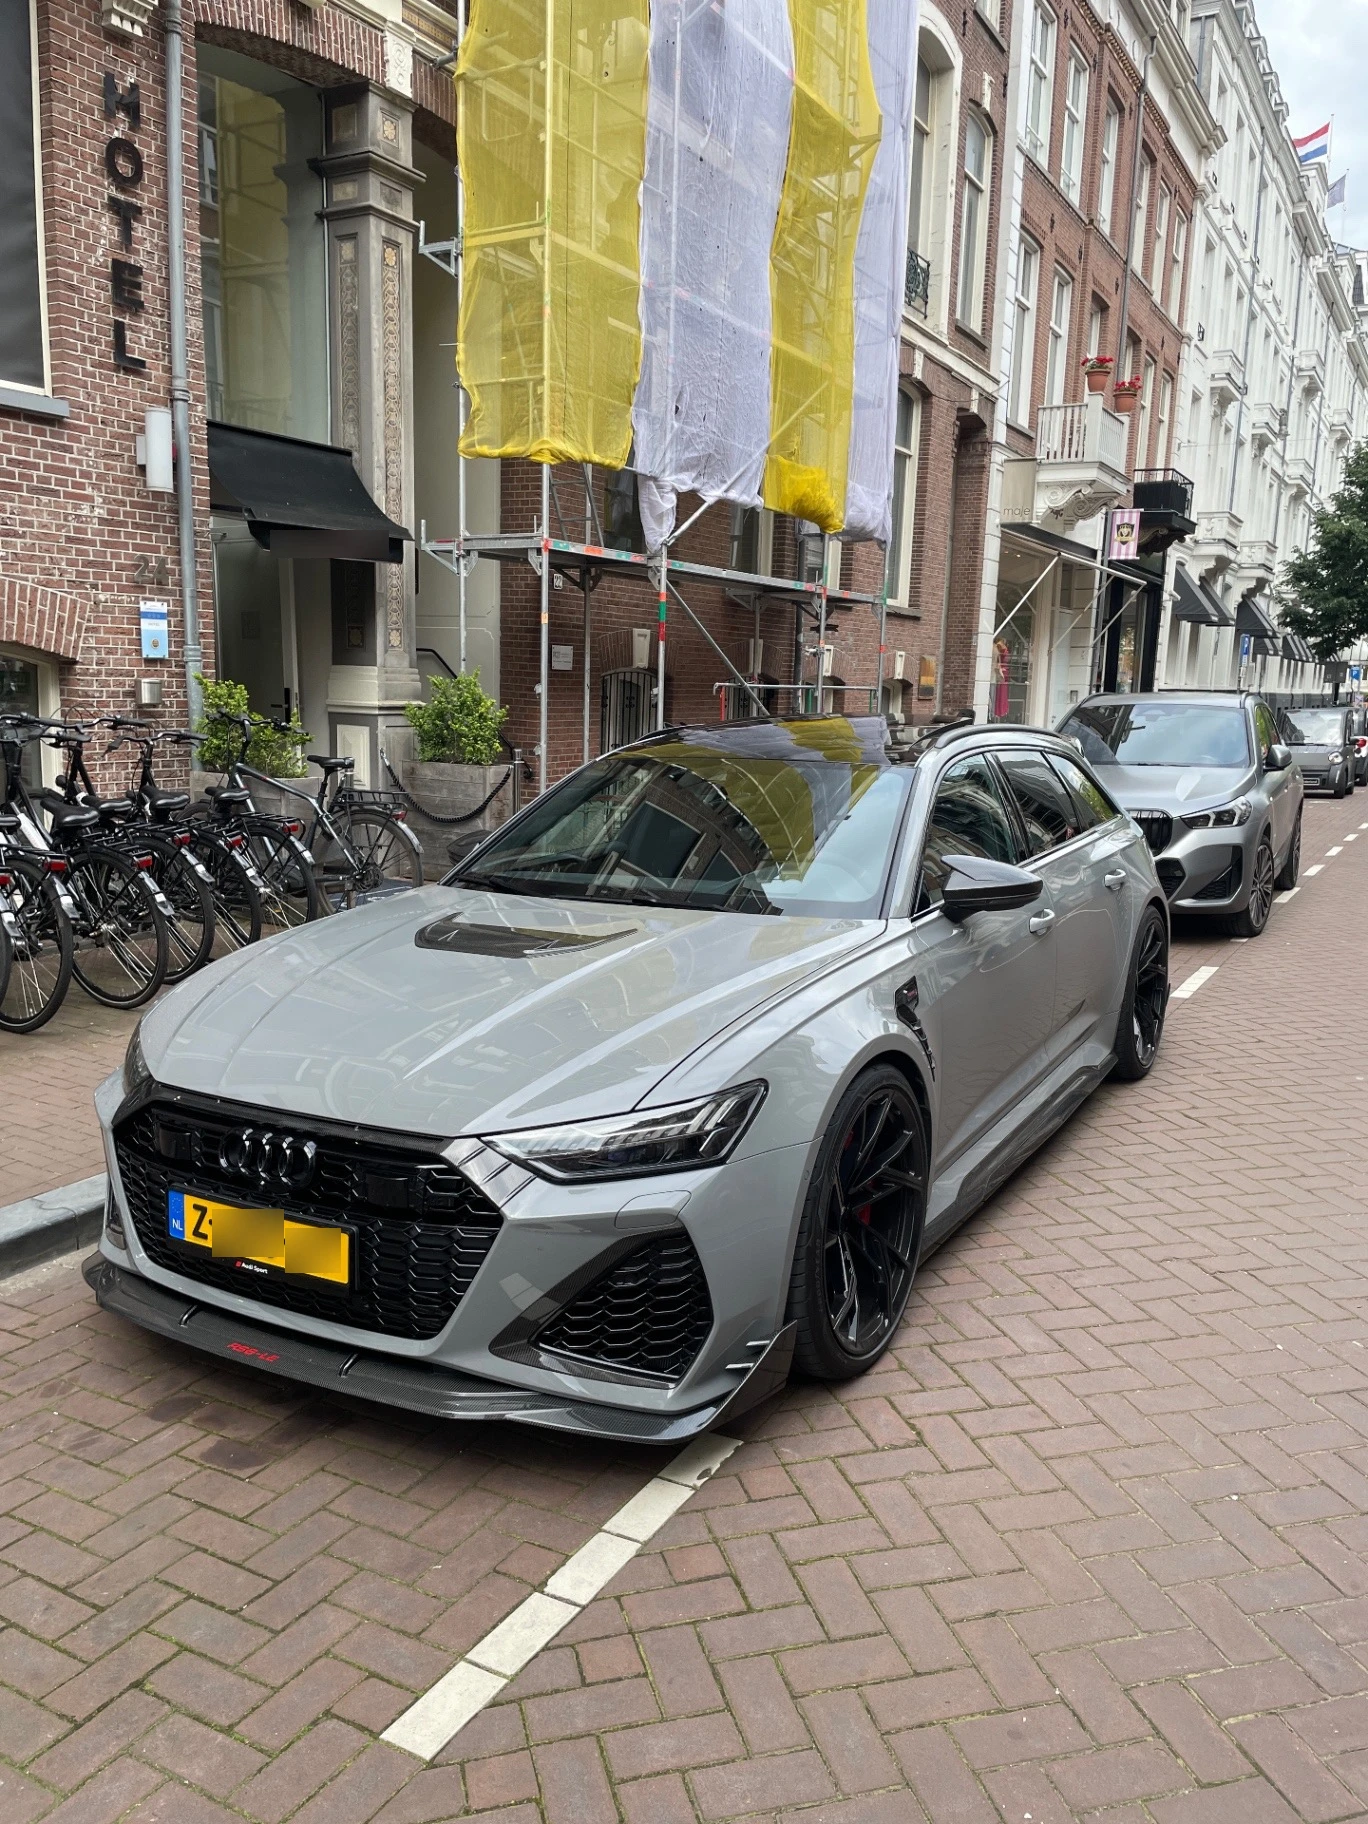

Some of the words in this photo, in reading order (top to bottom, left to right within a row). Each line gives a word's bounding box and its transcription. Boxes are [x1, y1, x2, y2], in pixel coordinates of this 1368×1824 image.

[103, 70, 146, 370] HOTEL
[1003, 506, 1031, 518] maje
[134, 554, 170, 587] 24
[173, 1217, 183, 1231] NL
[241, 1262, 254, 1271] Audi
[253, 1264, 268, 1275] Sport
